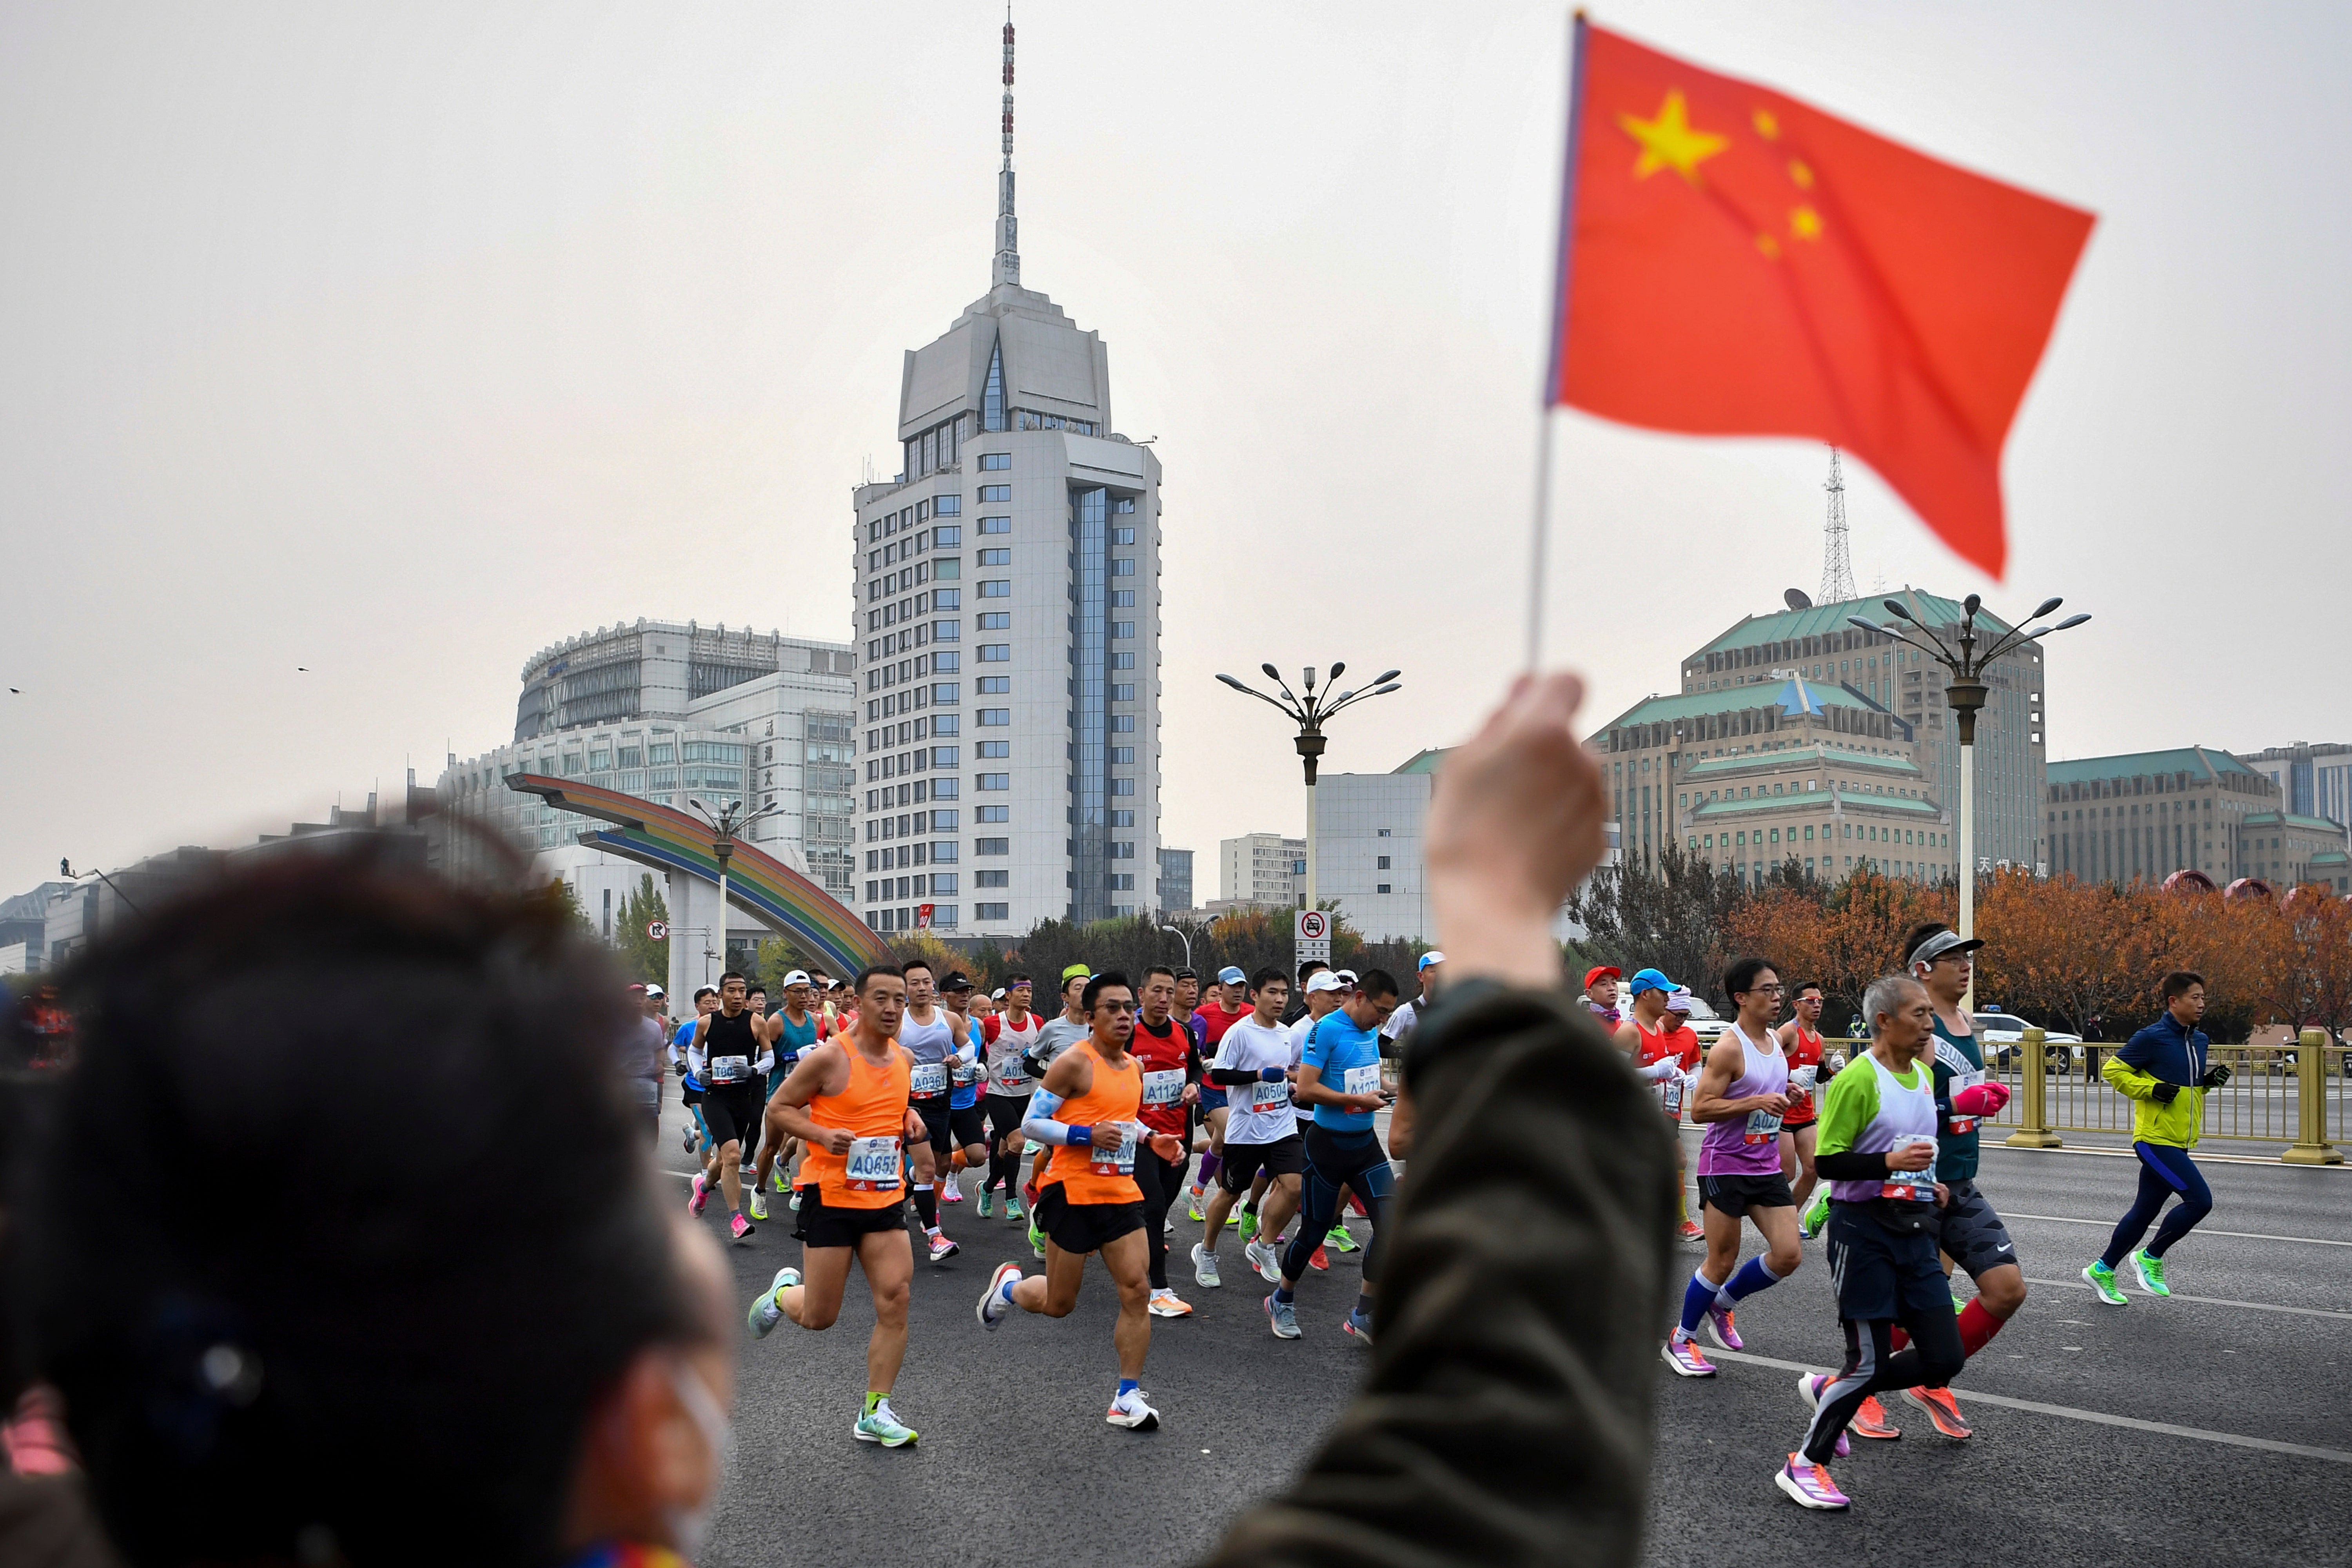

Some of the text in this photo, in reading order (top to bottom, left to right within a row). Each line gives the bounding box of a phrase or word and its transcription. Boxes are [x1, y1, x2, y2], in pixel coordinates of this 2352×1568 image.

[714, 1067, 733, 1077] T00
[1004, 1066, 1029, 1077] A01
[914, 1075, 945, 1089] A0361
[1147, 1082, 1183, 1100] A1125
[1256, 1082, 1286, 1101] A0504
[1667, 1092, 1679, 1104] 09
[851, 1155, 897, 1175] A0655
